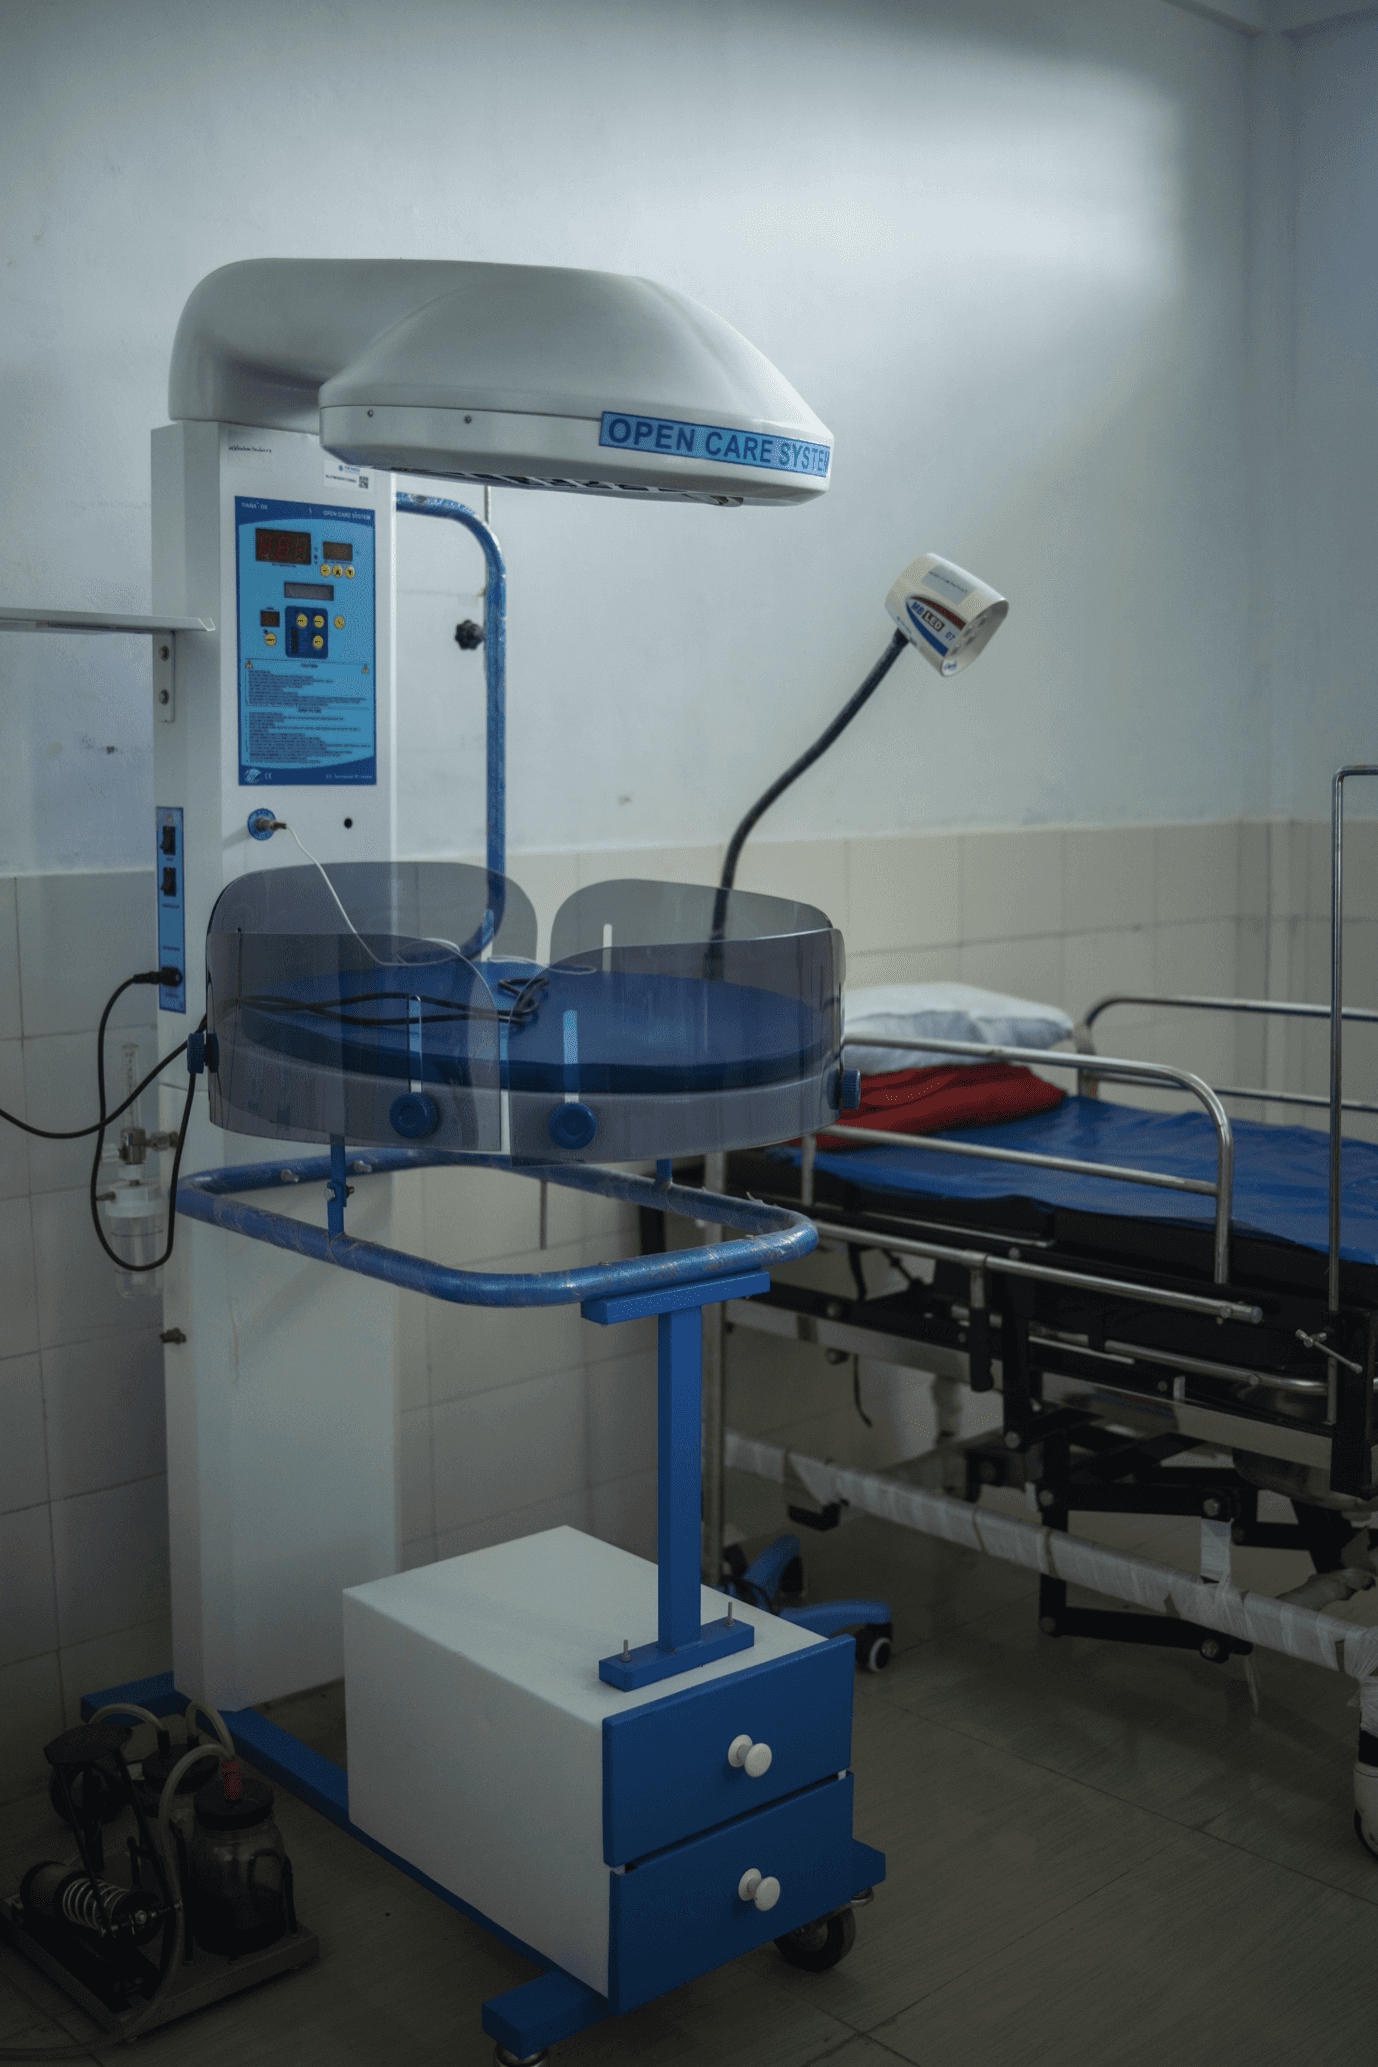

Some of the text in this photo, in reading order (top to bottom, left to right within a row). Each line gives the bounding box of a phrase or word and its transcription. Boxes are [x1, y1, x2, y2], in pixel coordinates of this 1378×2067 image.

[609, 418, 695, 452] OPEN
[705, 432, 773, 463] CARE
[924, 612, 942, 630] LED
